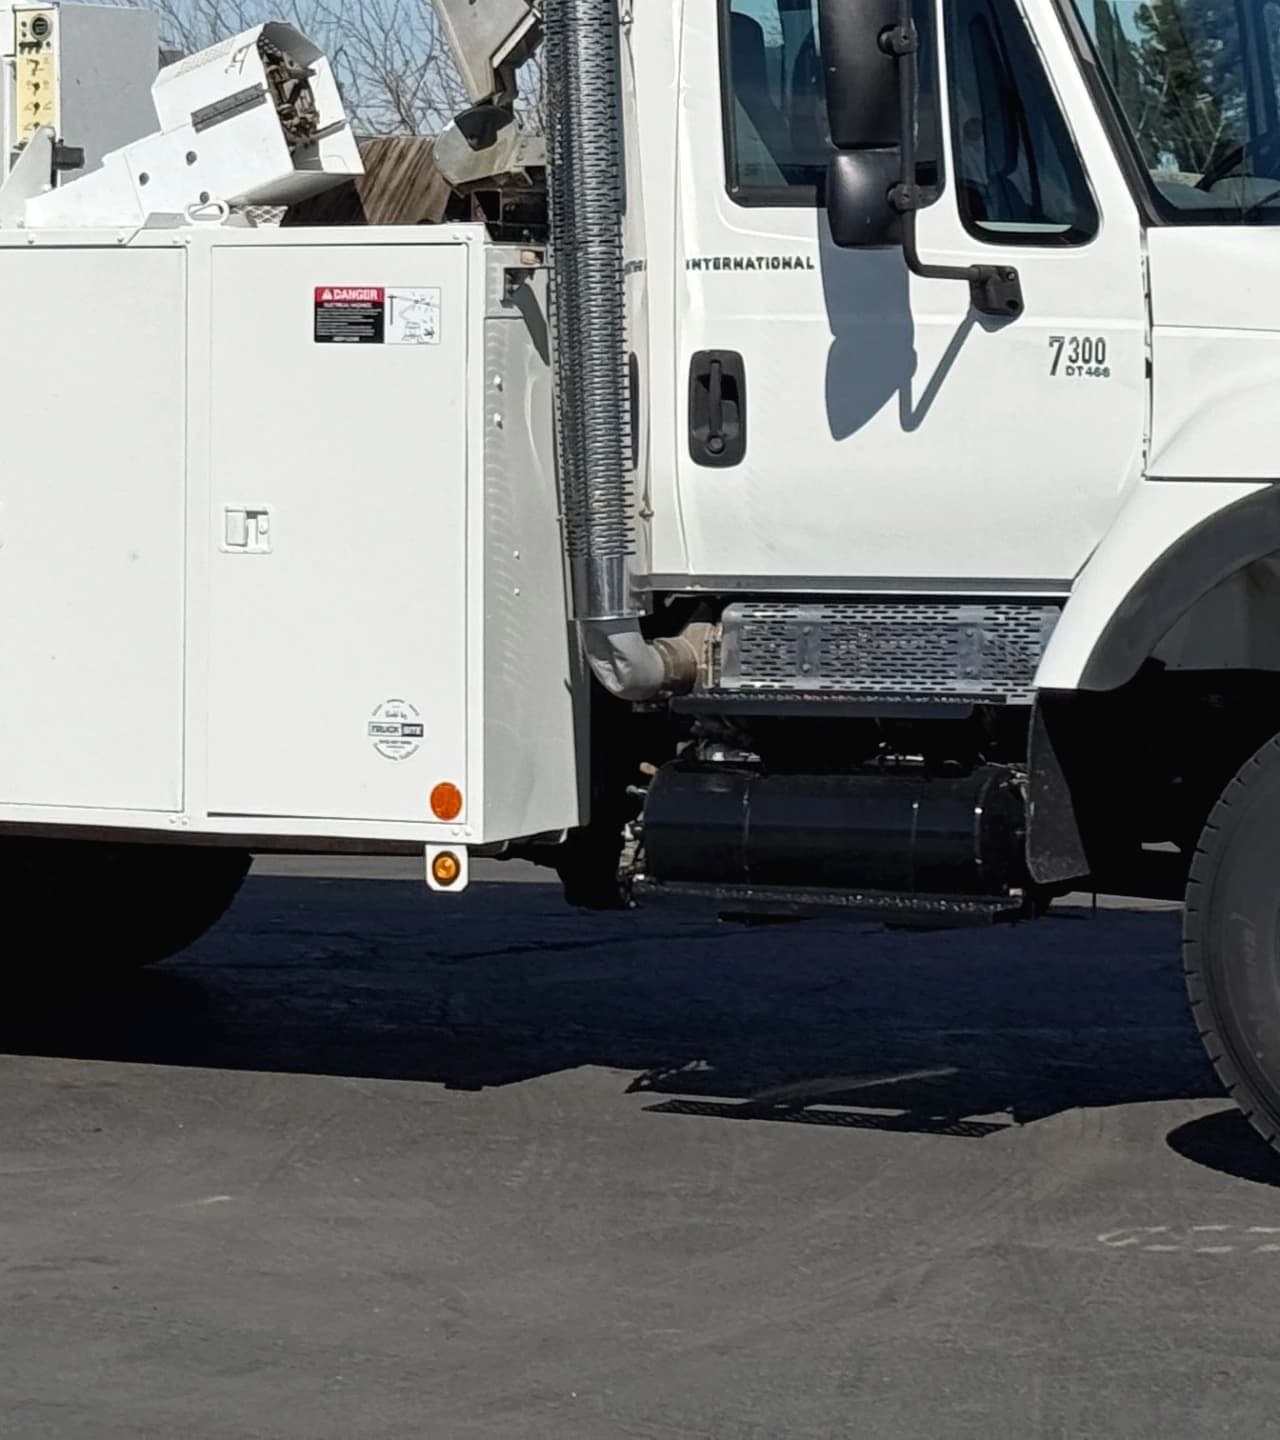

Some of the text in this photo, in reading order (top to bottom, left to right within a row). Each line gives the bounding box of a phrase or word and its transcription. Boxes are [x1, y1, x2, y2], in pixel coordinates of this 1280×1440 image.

[686, 256, 815, 271] INTERNATIONAL
[333, 288, 378, 300] DANGER
[1049, 335, 1106, 377] 7300
